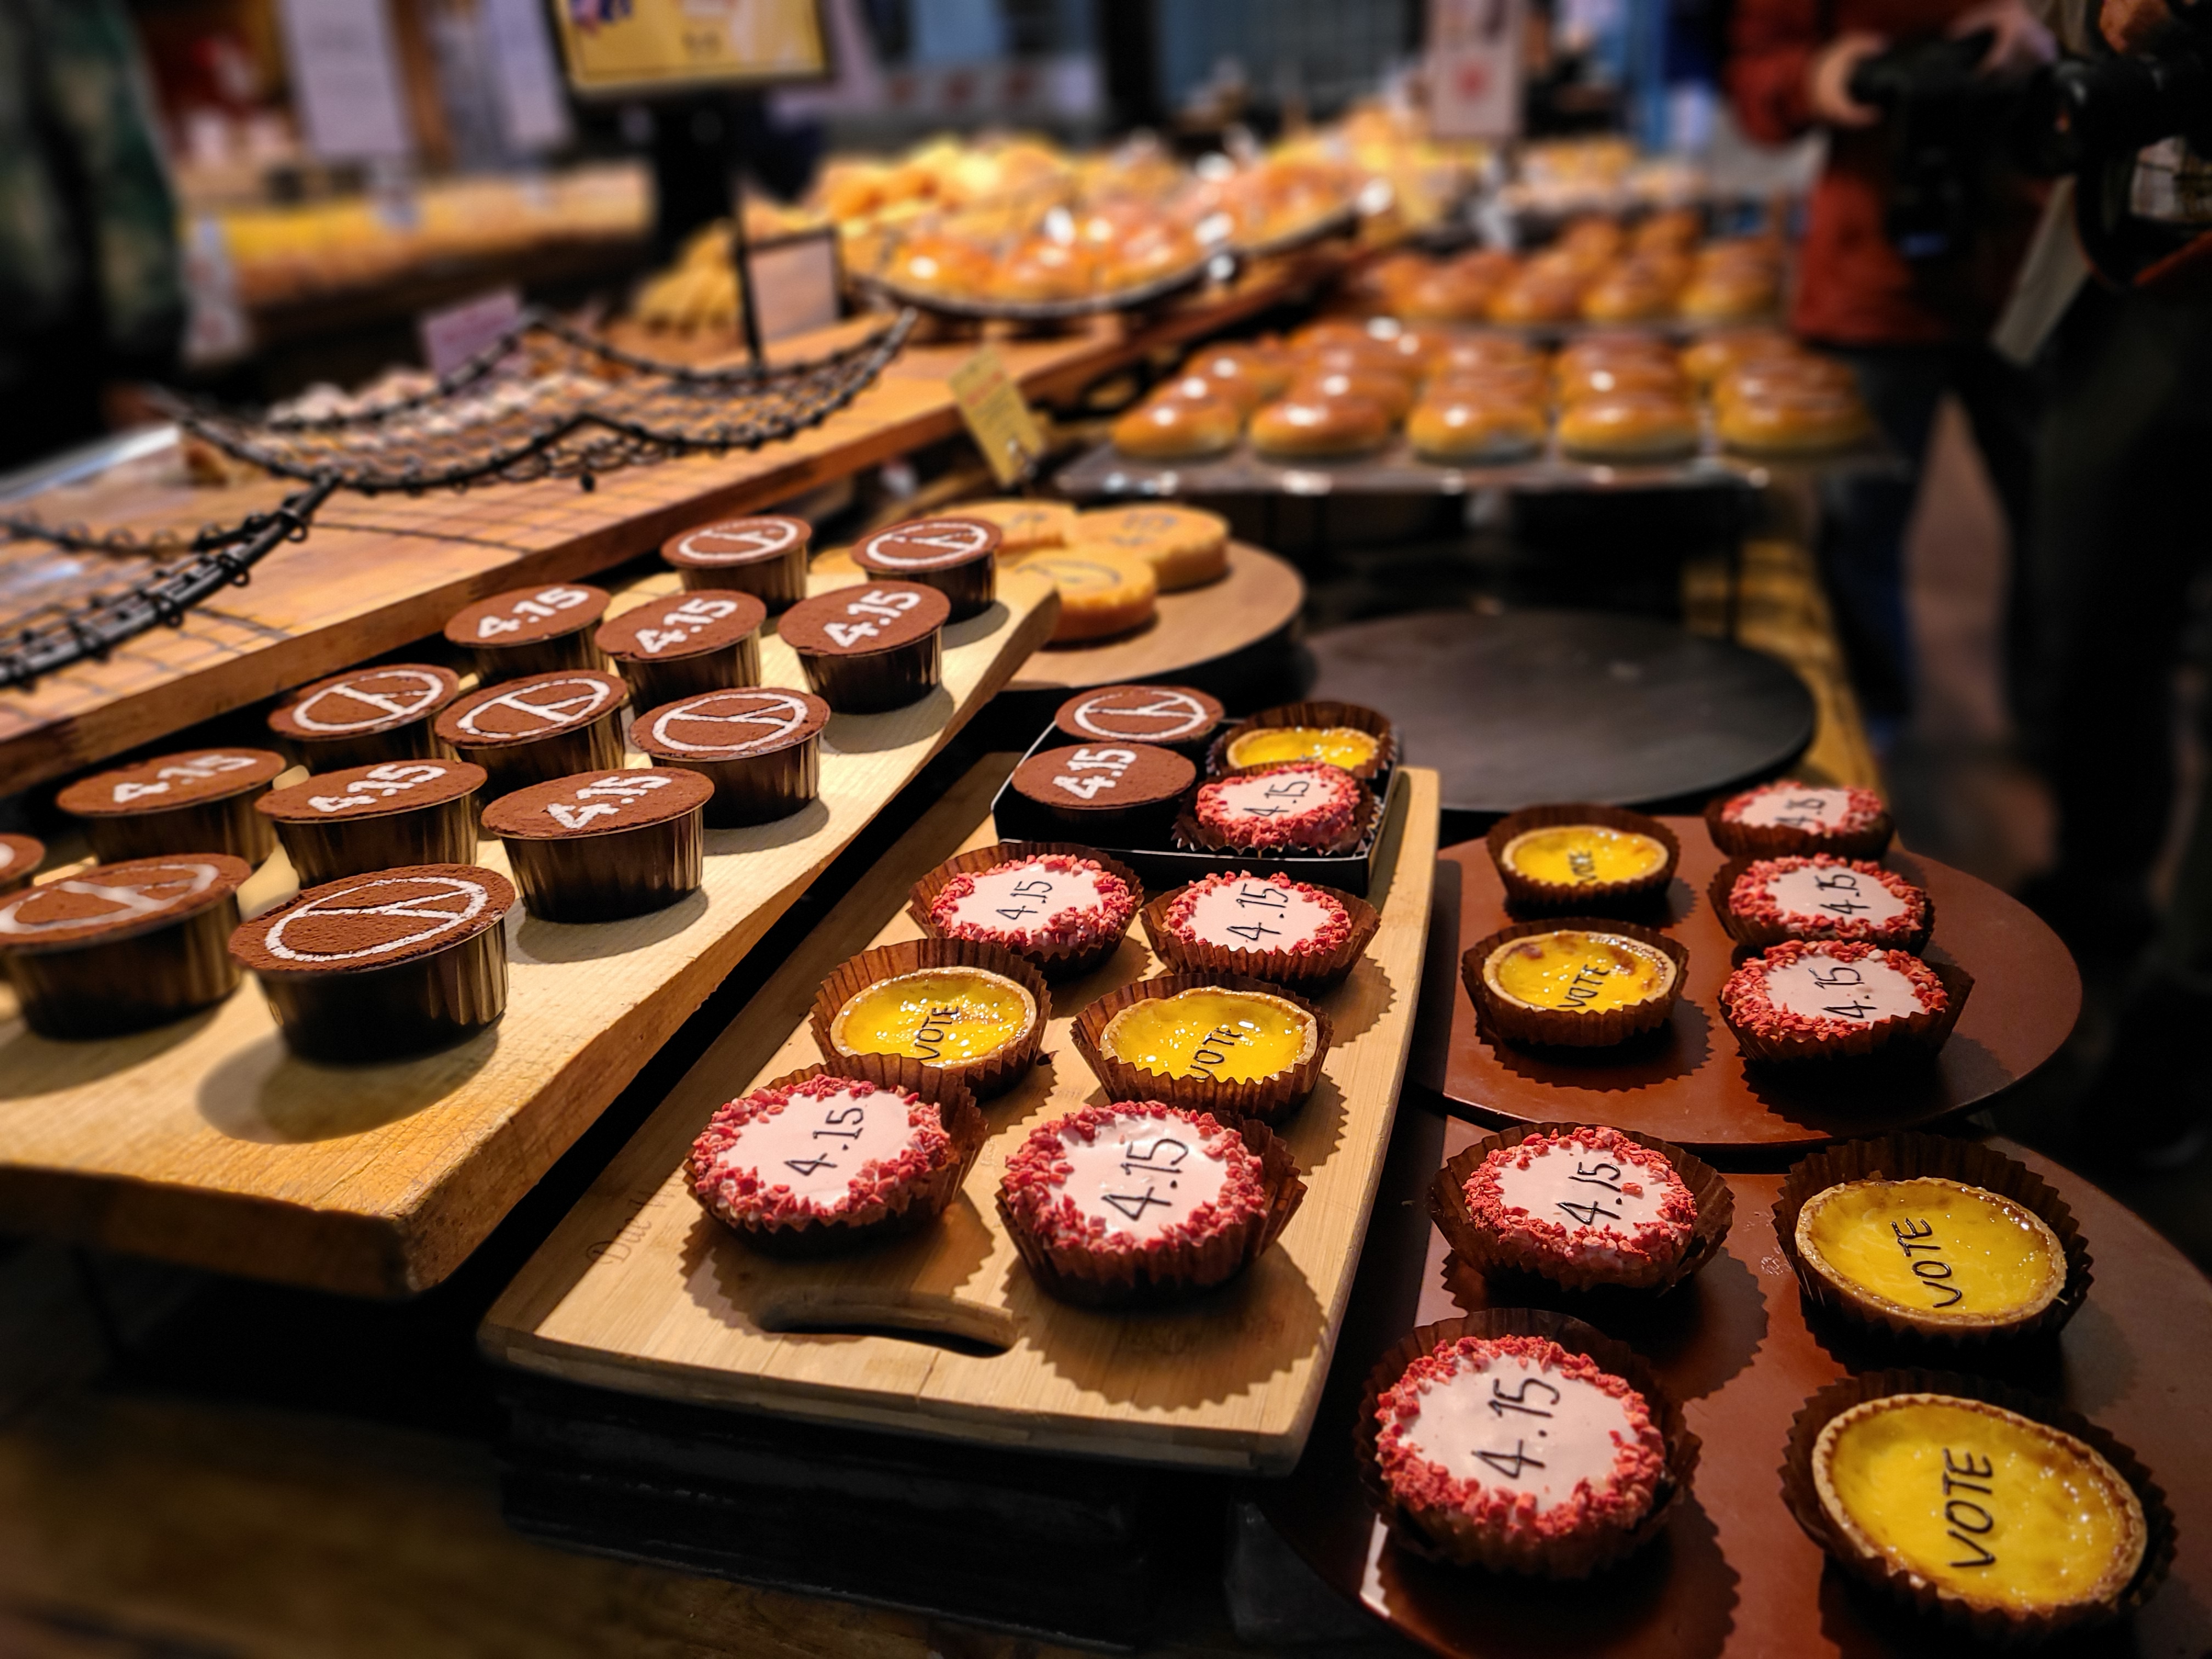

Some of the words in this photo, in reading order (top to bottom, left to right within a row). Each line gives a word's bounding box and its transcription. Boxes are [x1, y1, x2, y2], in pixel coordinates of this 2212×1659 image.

[476, 586, 591, 640] 4.15
[634, 597, 740, 654] 4.15
[823, 589, 922, 648] 4.15
[114, 755, 258, 803] 4.15
[307, 764, 448, 812] 4.15
[1052, 747, 1137, 800] 4.15
[1243, 780, 1310, 817] 4.15
[548, 775, 673, 831] 4.15
[997, 880, 1053, 921] 4.15
[1227, 882, 1289, 941] 4.15
[1818, 873, 1871, 916] 4.15
[1557, 963, 1611, 1011] VOTE
[1809, 966, 1876, 1019] 4.15
[914, 1004, 960, 1061] VOTE
[1189, 1027, 1244, 1081] VOTE
[783, 1106, 865, 1176] 4.15
[1101, 1137, 1189, 1221] 4.15
[1557, 1160, 1623, 1226] 4.15
[1891, 1217, 1955, 1309] VOTE
[1470, 1376, 1561, 1481] 4.15
[1941, 1446, 1998, 1571] VOTE
